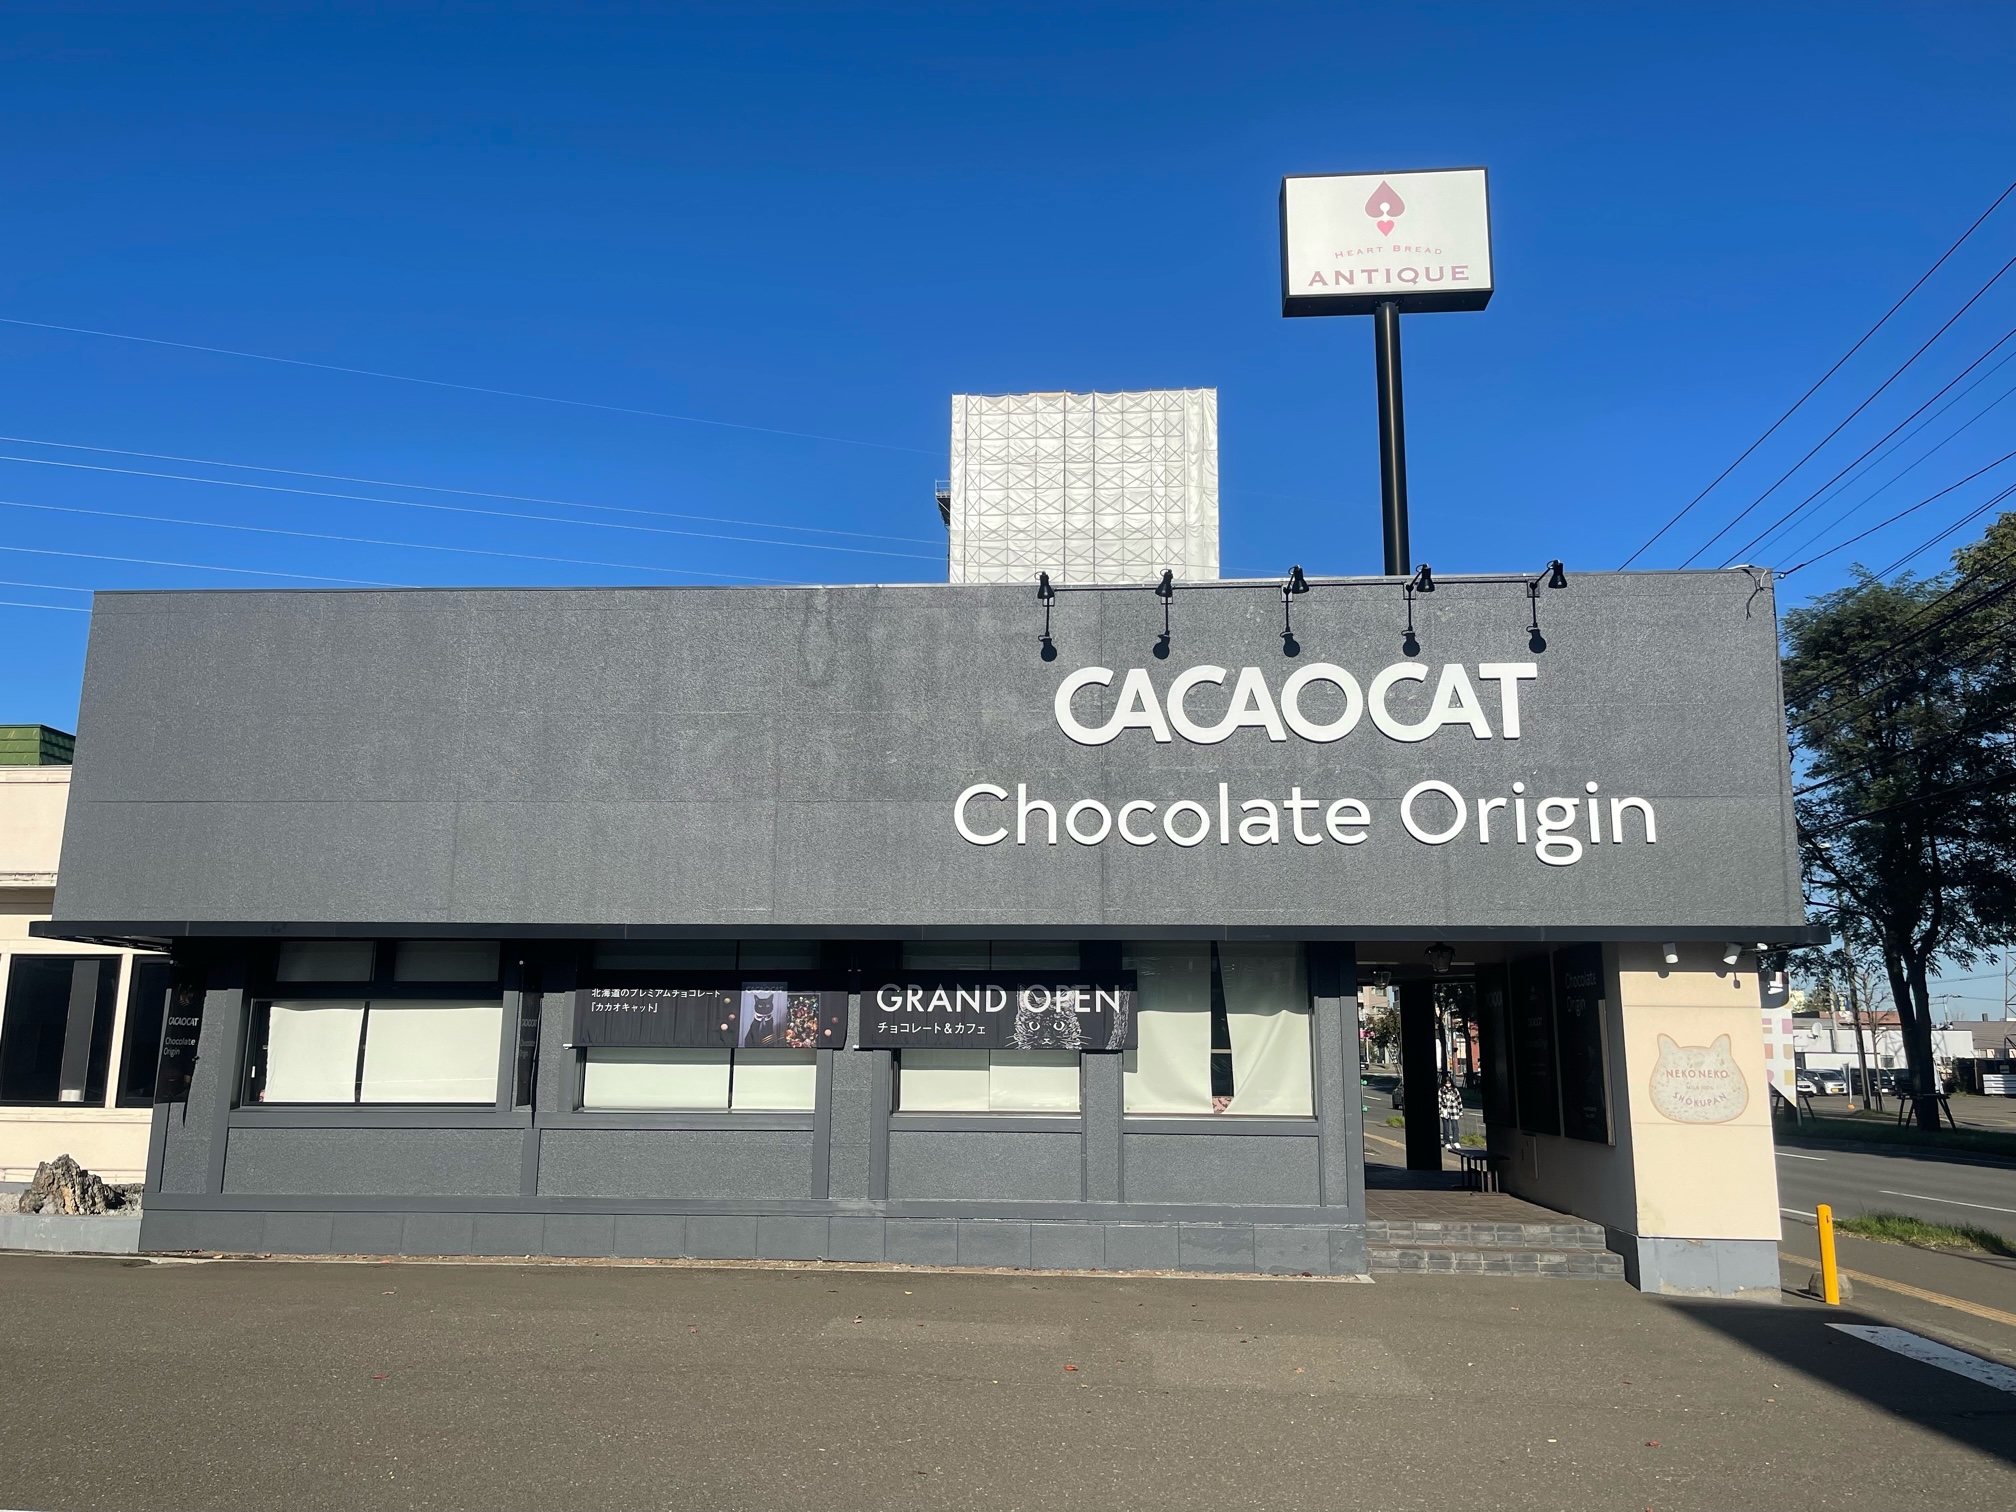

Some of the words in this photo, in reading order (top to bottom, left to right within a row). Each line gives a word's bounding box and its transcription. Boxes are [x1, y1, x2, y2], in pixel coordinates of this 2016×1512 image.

[1334, 246, 1383, 259] HEART
[1392, 244, 1442, 255] BREAD
[1307, 264, 1469, 287] ANTIQUE
[1054, 661, 1538, 746] CACAOCAT
[953, 782, 1371, 847] Chocolate
[1400, 779, 1657, 867] Origin
[591, 988, 722, 999] 北海道のプレミアムチョコレート
[876, 983, 1007, 1012] GRAND
[1023, 983, 1121, 1013] OPEN
[168, 1017, 199, 1026] CACAOCAT
[165, 1037, 196, 1045] Chocolate
[163, 1047, 180, 1057] Origin
[1665, 1069, 1696, 1079] NEKO
[1698, 1069, 1729, 1079] NEKO
[1672, 1091, 1728, 1108] SHOKUPAN
